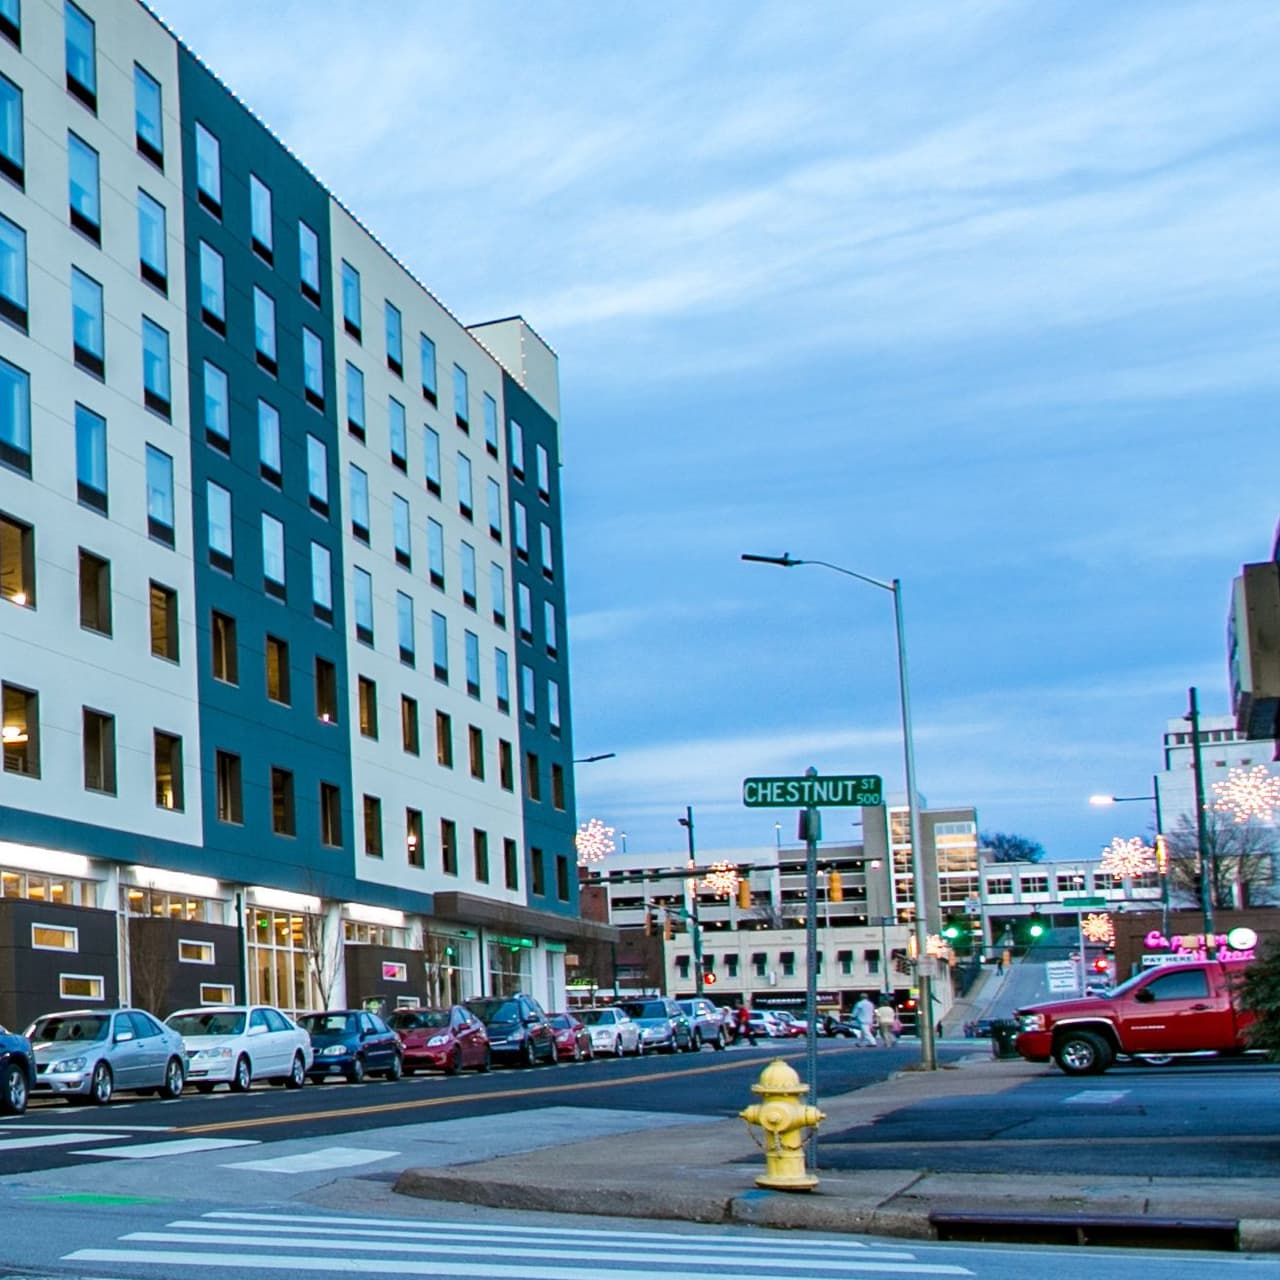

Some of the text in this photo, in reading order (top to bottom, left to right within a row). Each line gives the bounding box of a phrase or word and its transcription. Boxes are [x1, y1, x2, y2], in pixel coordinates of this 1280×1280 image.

[744, 778, 876, 803] CHESTNUT ST
[856, 793, 880, 805] 500
